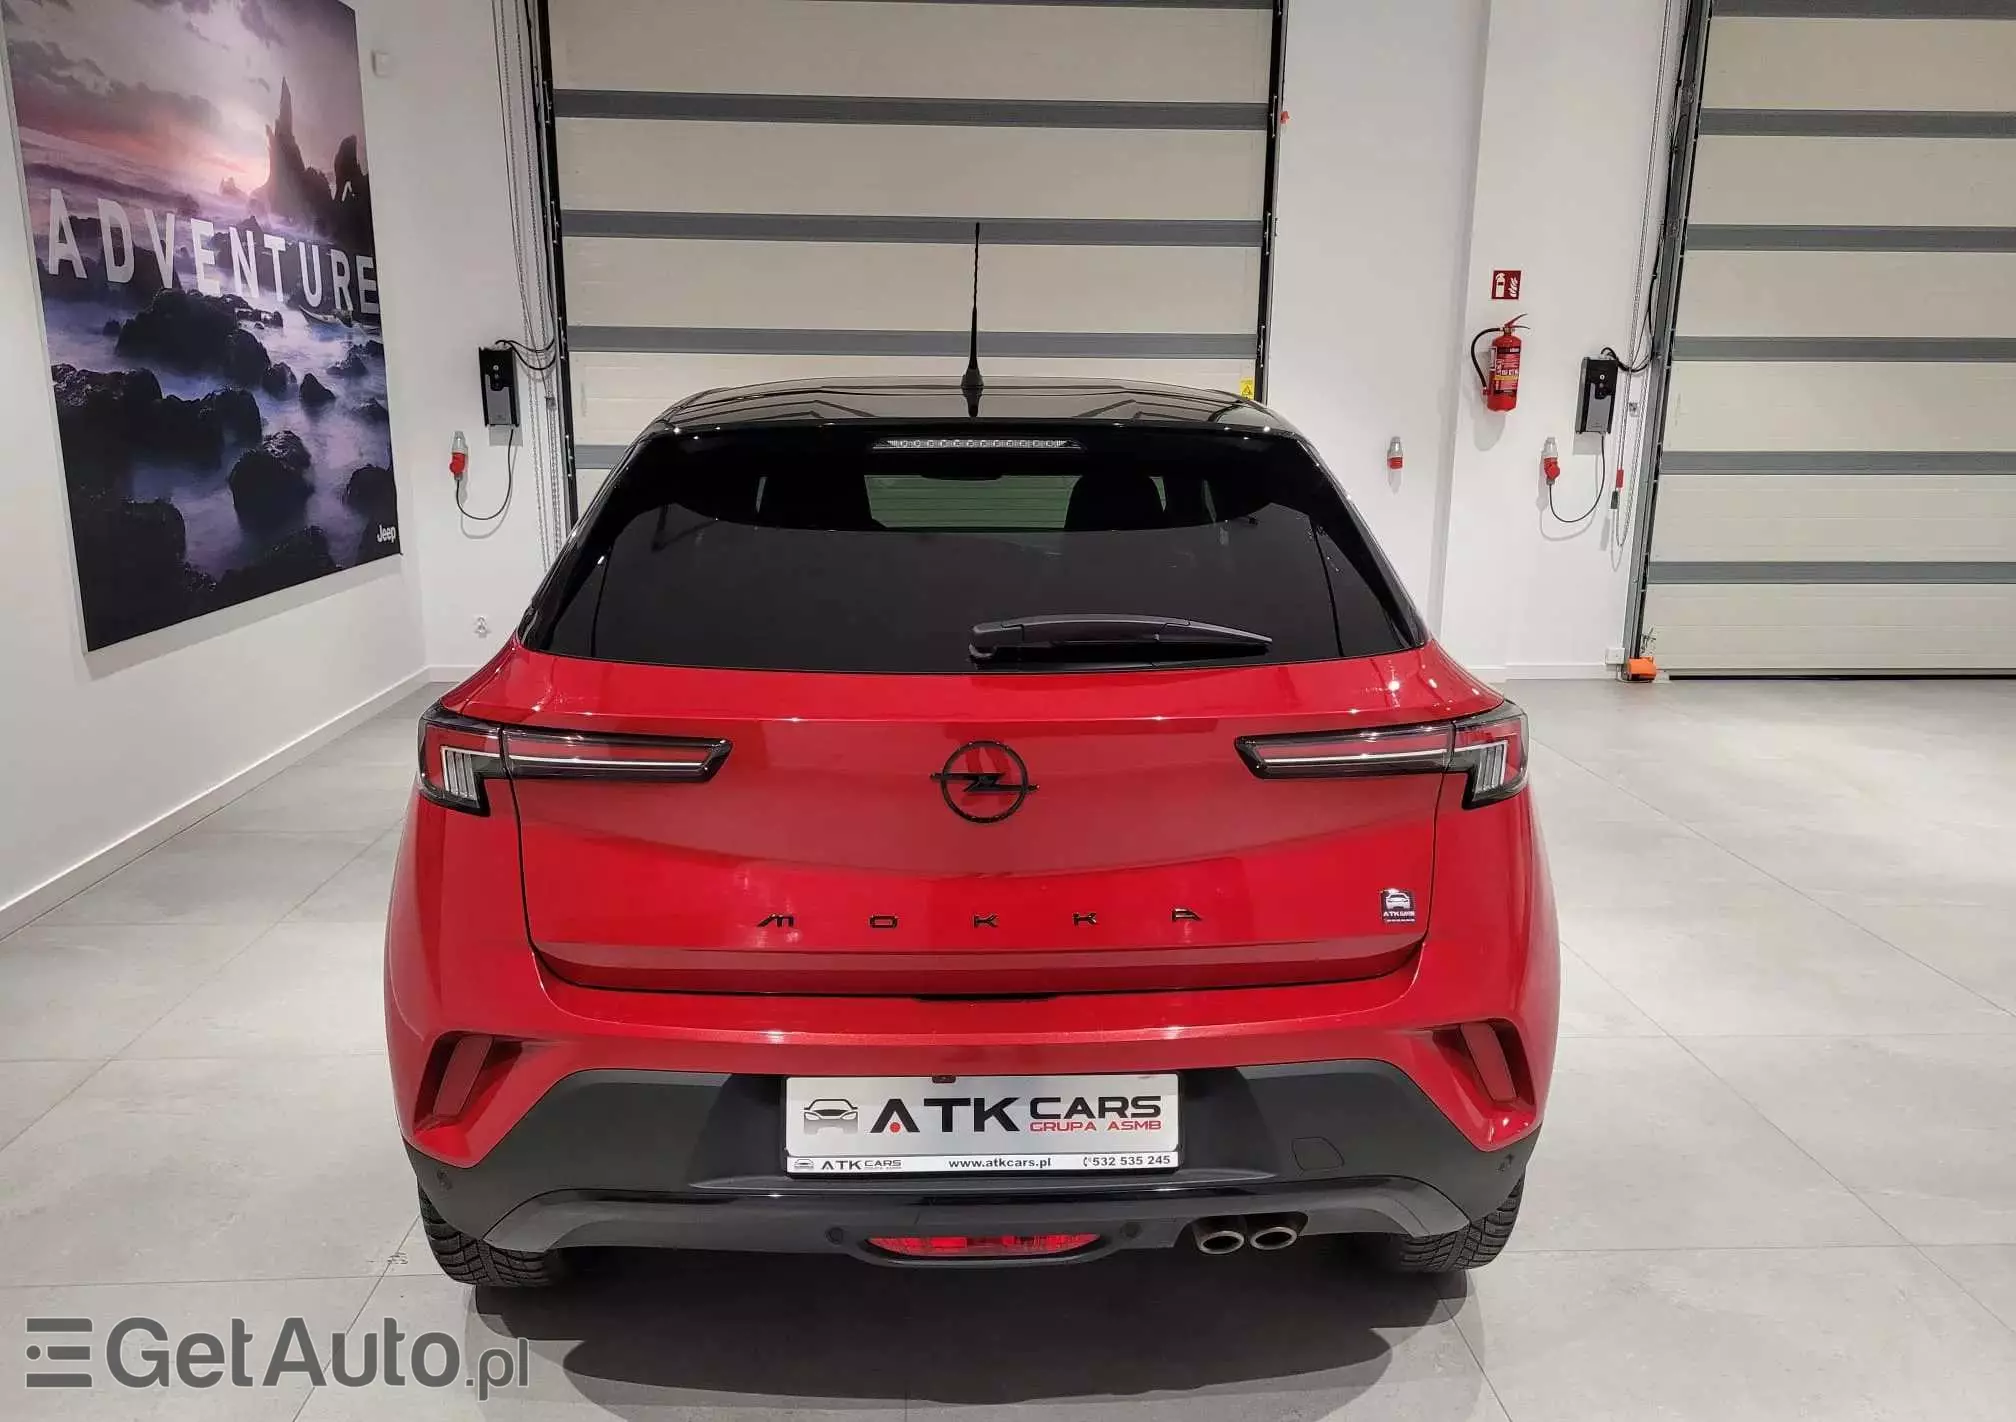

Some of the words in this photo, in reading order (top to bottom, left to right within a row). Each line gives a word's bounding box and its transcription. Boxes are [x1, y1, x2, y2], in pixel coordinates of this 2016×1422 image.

[48, 188, 380, 315] ADVENTURE
[376, 524, 396, 543] Jeep
[756, 907, 1204, 928] MOKKA
[870, 1097, 1021, 1133] ATK
[1030, 1096, 1162, 1119] CARS
[1030, 1120, 1098, 1132] GRUPA
[1107, 1120, 1162, 1131] ASMB
[821, 1160, 862, 1170] ATK
[864, 1160, 902, 1168] CARS
[949, 1157, 1051, 1169] www.atkcars.pl
[1092, 1156, 1116, 1167] 532
[1120, 1156, 1144, 1166] 535
[1147, 1155, 1171, 1165] 245
